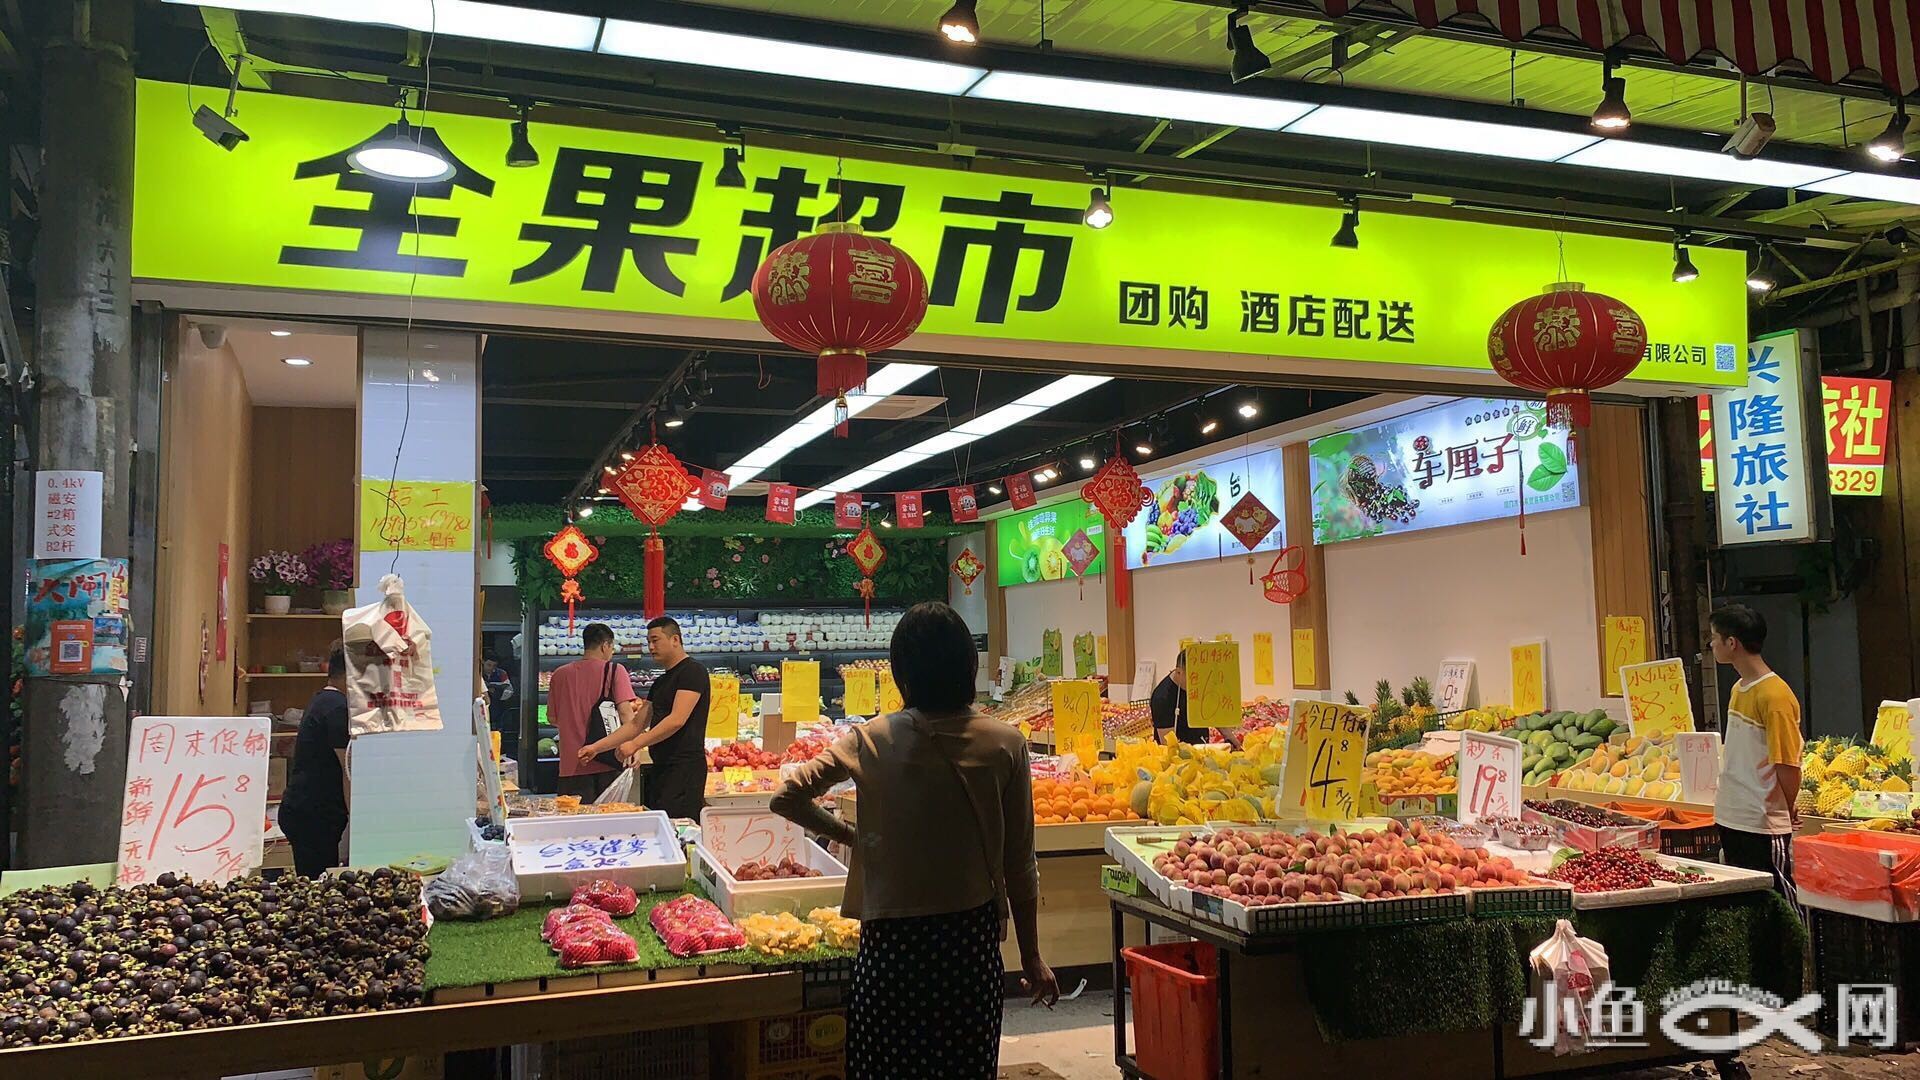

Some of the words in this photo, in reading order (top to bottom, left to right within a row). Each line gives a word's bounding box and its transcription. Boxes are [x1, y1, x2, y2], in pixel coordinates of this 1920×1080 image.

[277, 122, 1085, 325] 全果超市
[1119, 280, 1209, 330] 团购
[1239, 289, 1416, 344] 酒店配送
[1411, 432, 1520, 490] 车厘子
[1727, 345, 1793, 536] 兴隆旅社
[47, 524, 76, 537] 式变
[139, 722, 269, 765] 周末促销
